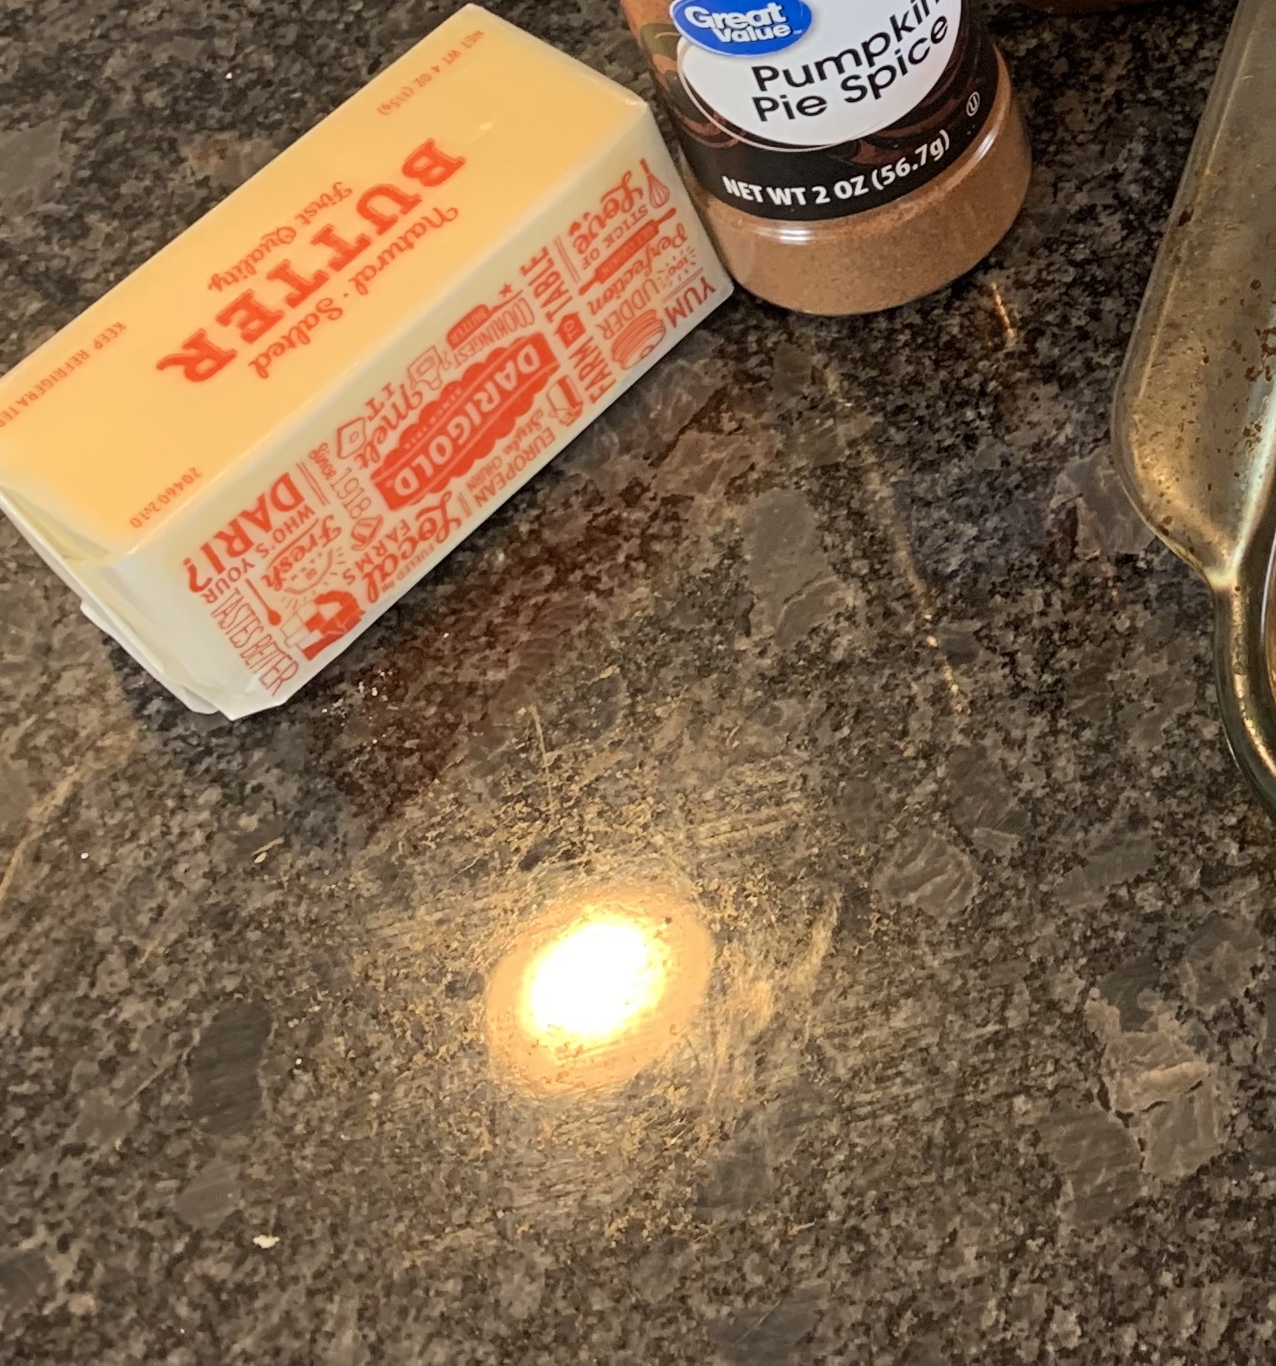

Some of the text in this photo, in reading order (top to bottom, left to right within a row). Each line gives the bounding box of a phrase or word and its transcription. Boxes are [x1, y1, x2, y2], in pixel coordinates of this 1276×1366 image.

[684, 1, 787, 30] Great
[712, 23, 791, 43] Value
[751, 13, 949, 123] Pie Spice
[293, 180, 354, 226] First
[722, 129, 950, 207] NET WT 2 OZ (56.7g)
[571, 168, 645, 256] Love
[581, 202, 649, 271] STICK OF
[154, 137, 467, 384] BUTTER
[246, 205, 460, 380] Natural Salted
[585, 221, 689, 316] Perfection
[92, 320, 127, 351] KEEP
[518, 245, 616, 404] FARM TO TABLE
[594, 276, 661, 341] UDDER
[662, 274, 717, 329] YUM
[363, 381, 396, 423] IT
[390, 340, 542, 502] DARIGOLD
[327, 465, 373, 522] 1918
[465, 455, 500, 492] CHURN
[472, 425, 556, 508] EUROPEAN
[182, 471, 306, 594] DARI?
[200, 502, 316, 605] WHO'S YOUR
[259, 513, 342, 592] Fresh
[340, 517, 412, 586] FARMS
[360, 488, 462, 604] Local
[209, 585, 265, 650] TASTES
